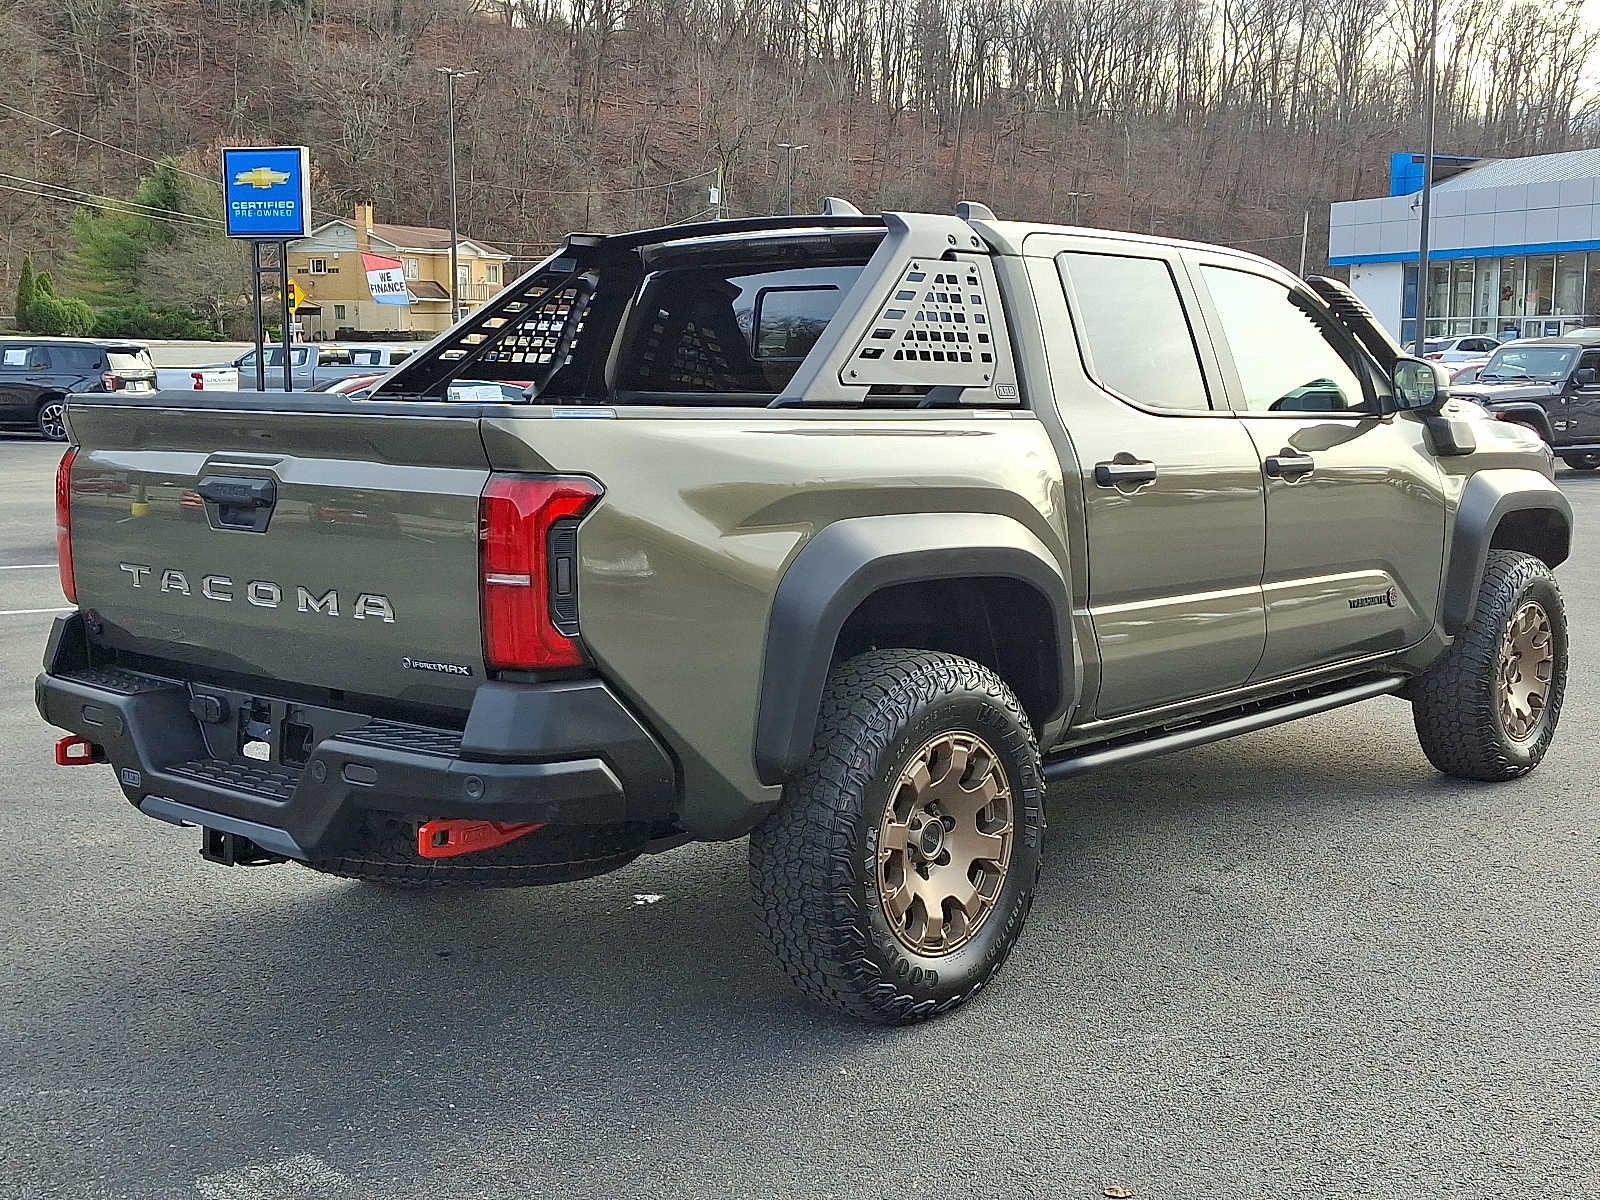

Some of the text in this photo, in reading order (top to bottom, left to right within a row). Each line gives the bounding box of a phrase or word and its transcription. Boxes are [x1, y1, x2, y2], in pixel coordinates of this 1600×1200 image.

[231, 200, 295, 210] CERTIFIED
[379, 272, 393, 282] WE
[370, 281, 406, 294] FINANCE
[119, 561, 396, 624] TACOMA
[438, 663, 470, 676] MAX
